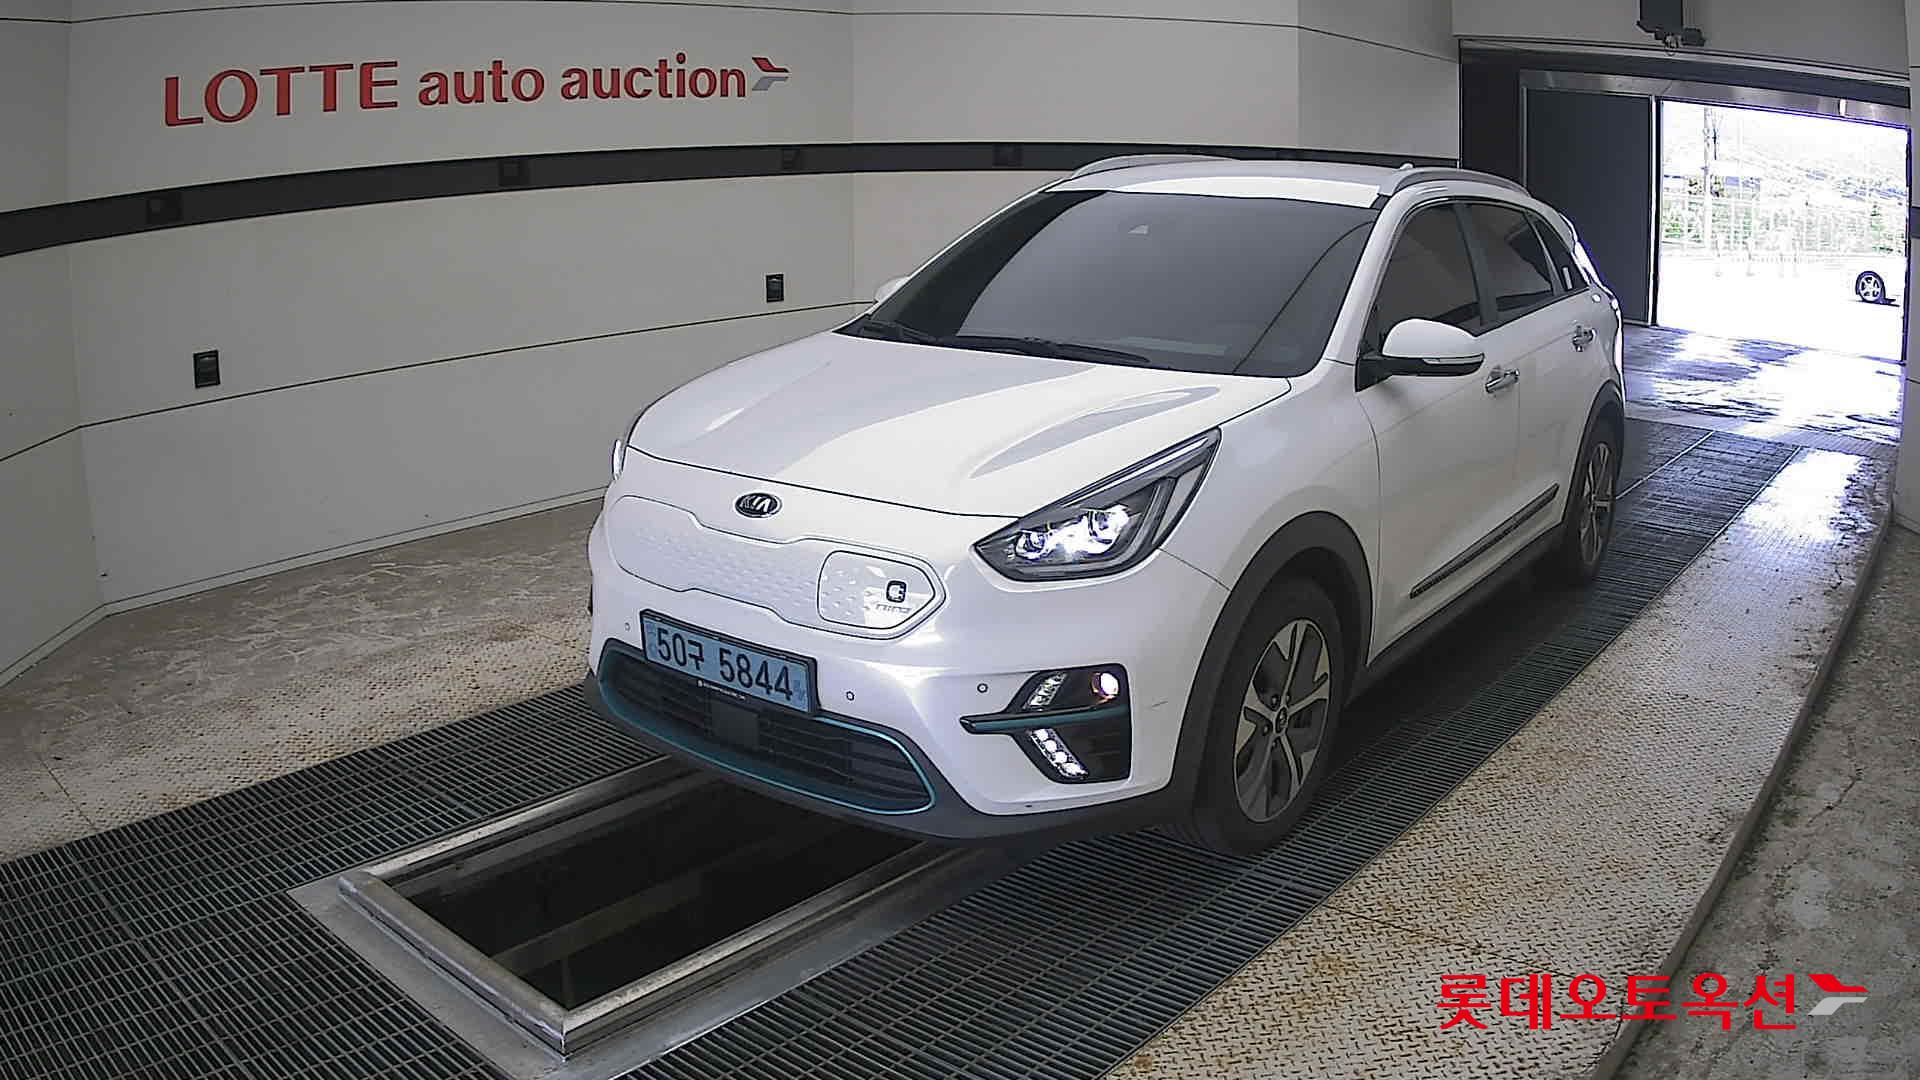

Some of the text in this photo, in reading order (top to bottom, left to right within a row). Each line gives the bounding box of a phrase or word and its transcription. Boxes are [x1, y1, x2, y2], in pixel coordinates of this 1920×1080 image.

[165, 52, 747, 127] LOTTE auto auction
[719, 648, 792, 700] 5844
